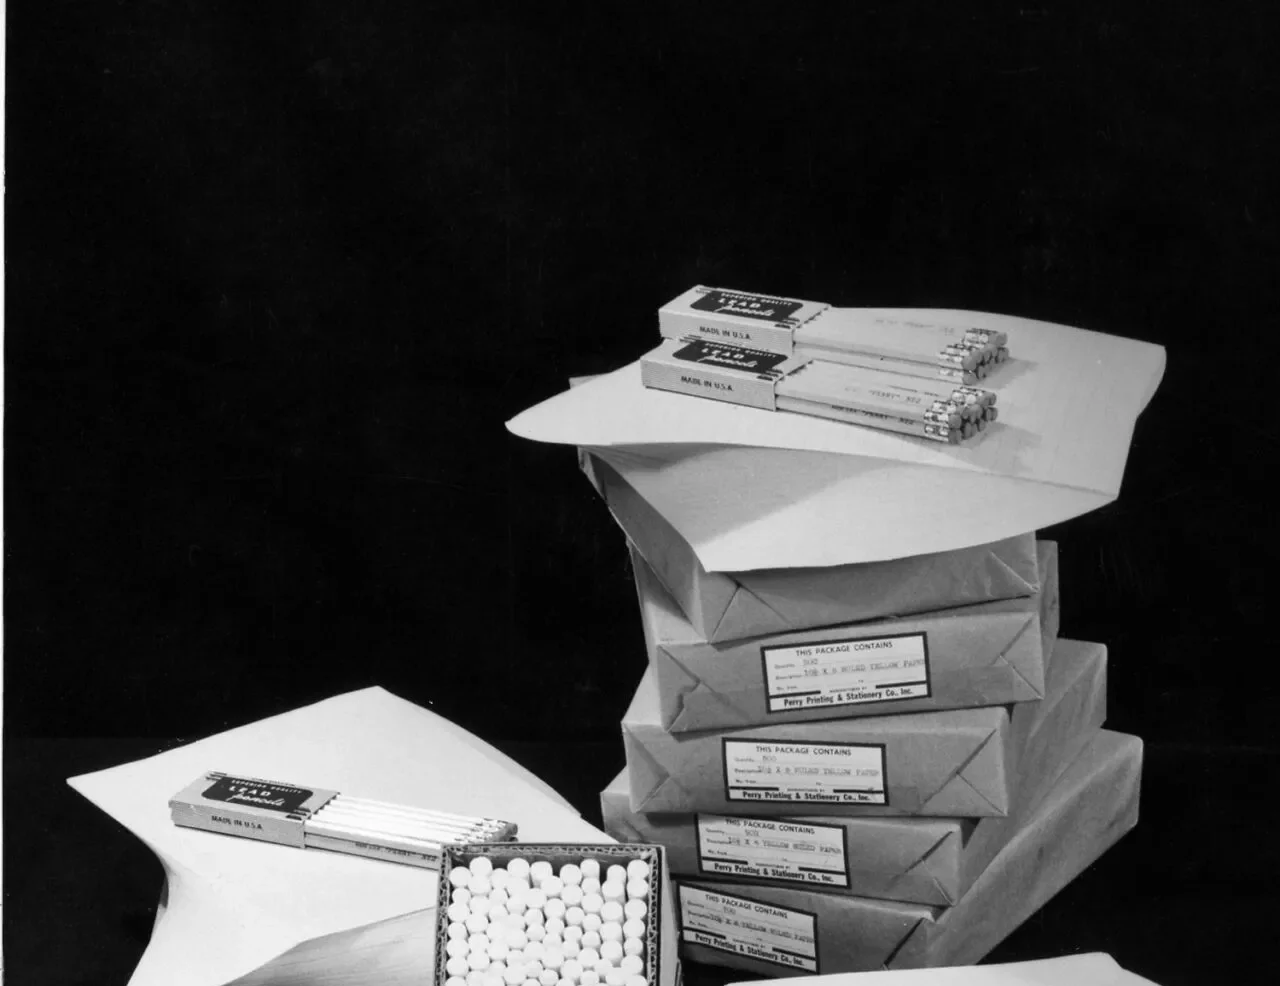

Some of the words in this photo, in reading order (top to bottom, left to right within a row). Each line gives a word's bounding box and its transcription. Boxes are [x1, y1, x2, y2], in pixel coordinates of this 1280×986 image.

[700, 326, 720, 336] MADE
[722, 329, 730, 337] IN
[681, 376, 702, 386] MADE
[703, 380, 712, 388] IN
[796, 649, 812, 657] THIS
[815, 645, 851, 656] PACKAGE
[854, 641, 894, 653] CONTAINS
[784, 698, 803, 708] Perry
[806, 694, 835, 706] Printing
[837, 694, 844, 702] &
[846, 689, 883, 702] Stationery
[756, 746, 772, 754] THIS
[775, 746, 809, 755] PACKAGE
[814, 747, 852, 757] CONTAINS
[228, 786, 272, 797] LEAD
[742, 791, 762, 800] Perry
[764, 792, 792, 800] Printing
[804, 792, 840, 802] Stationery
[212, 815, 232, 825] MADE
[234, 819, 242, 827] IN
[725, 818, 740, 826] THIS
[743, 820, 776, 831] PACKAGE
[778, 824, 816, 835] CONTAINS
[714, 862, 732, 873] Perry
[734, 864, 761, 876] Printing
[771, 868, 806, 880] Stationery
[705, 894, 720, 904] THIS
[722, 897, 752, 911] PACKAGE
[754, 904, 788, 919] CONTAINS
[695, 934, 712, 946] Perry
[713, 938, 737, 952] Printing
[747, 946, 779, 961] Stationery
